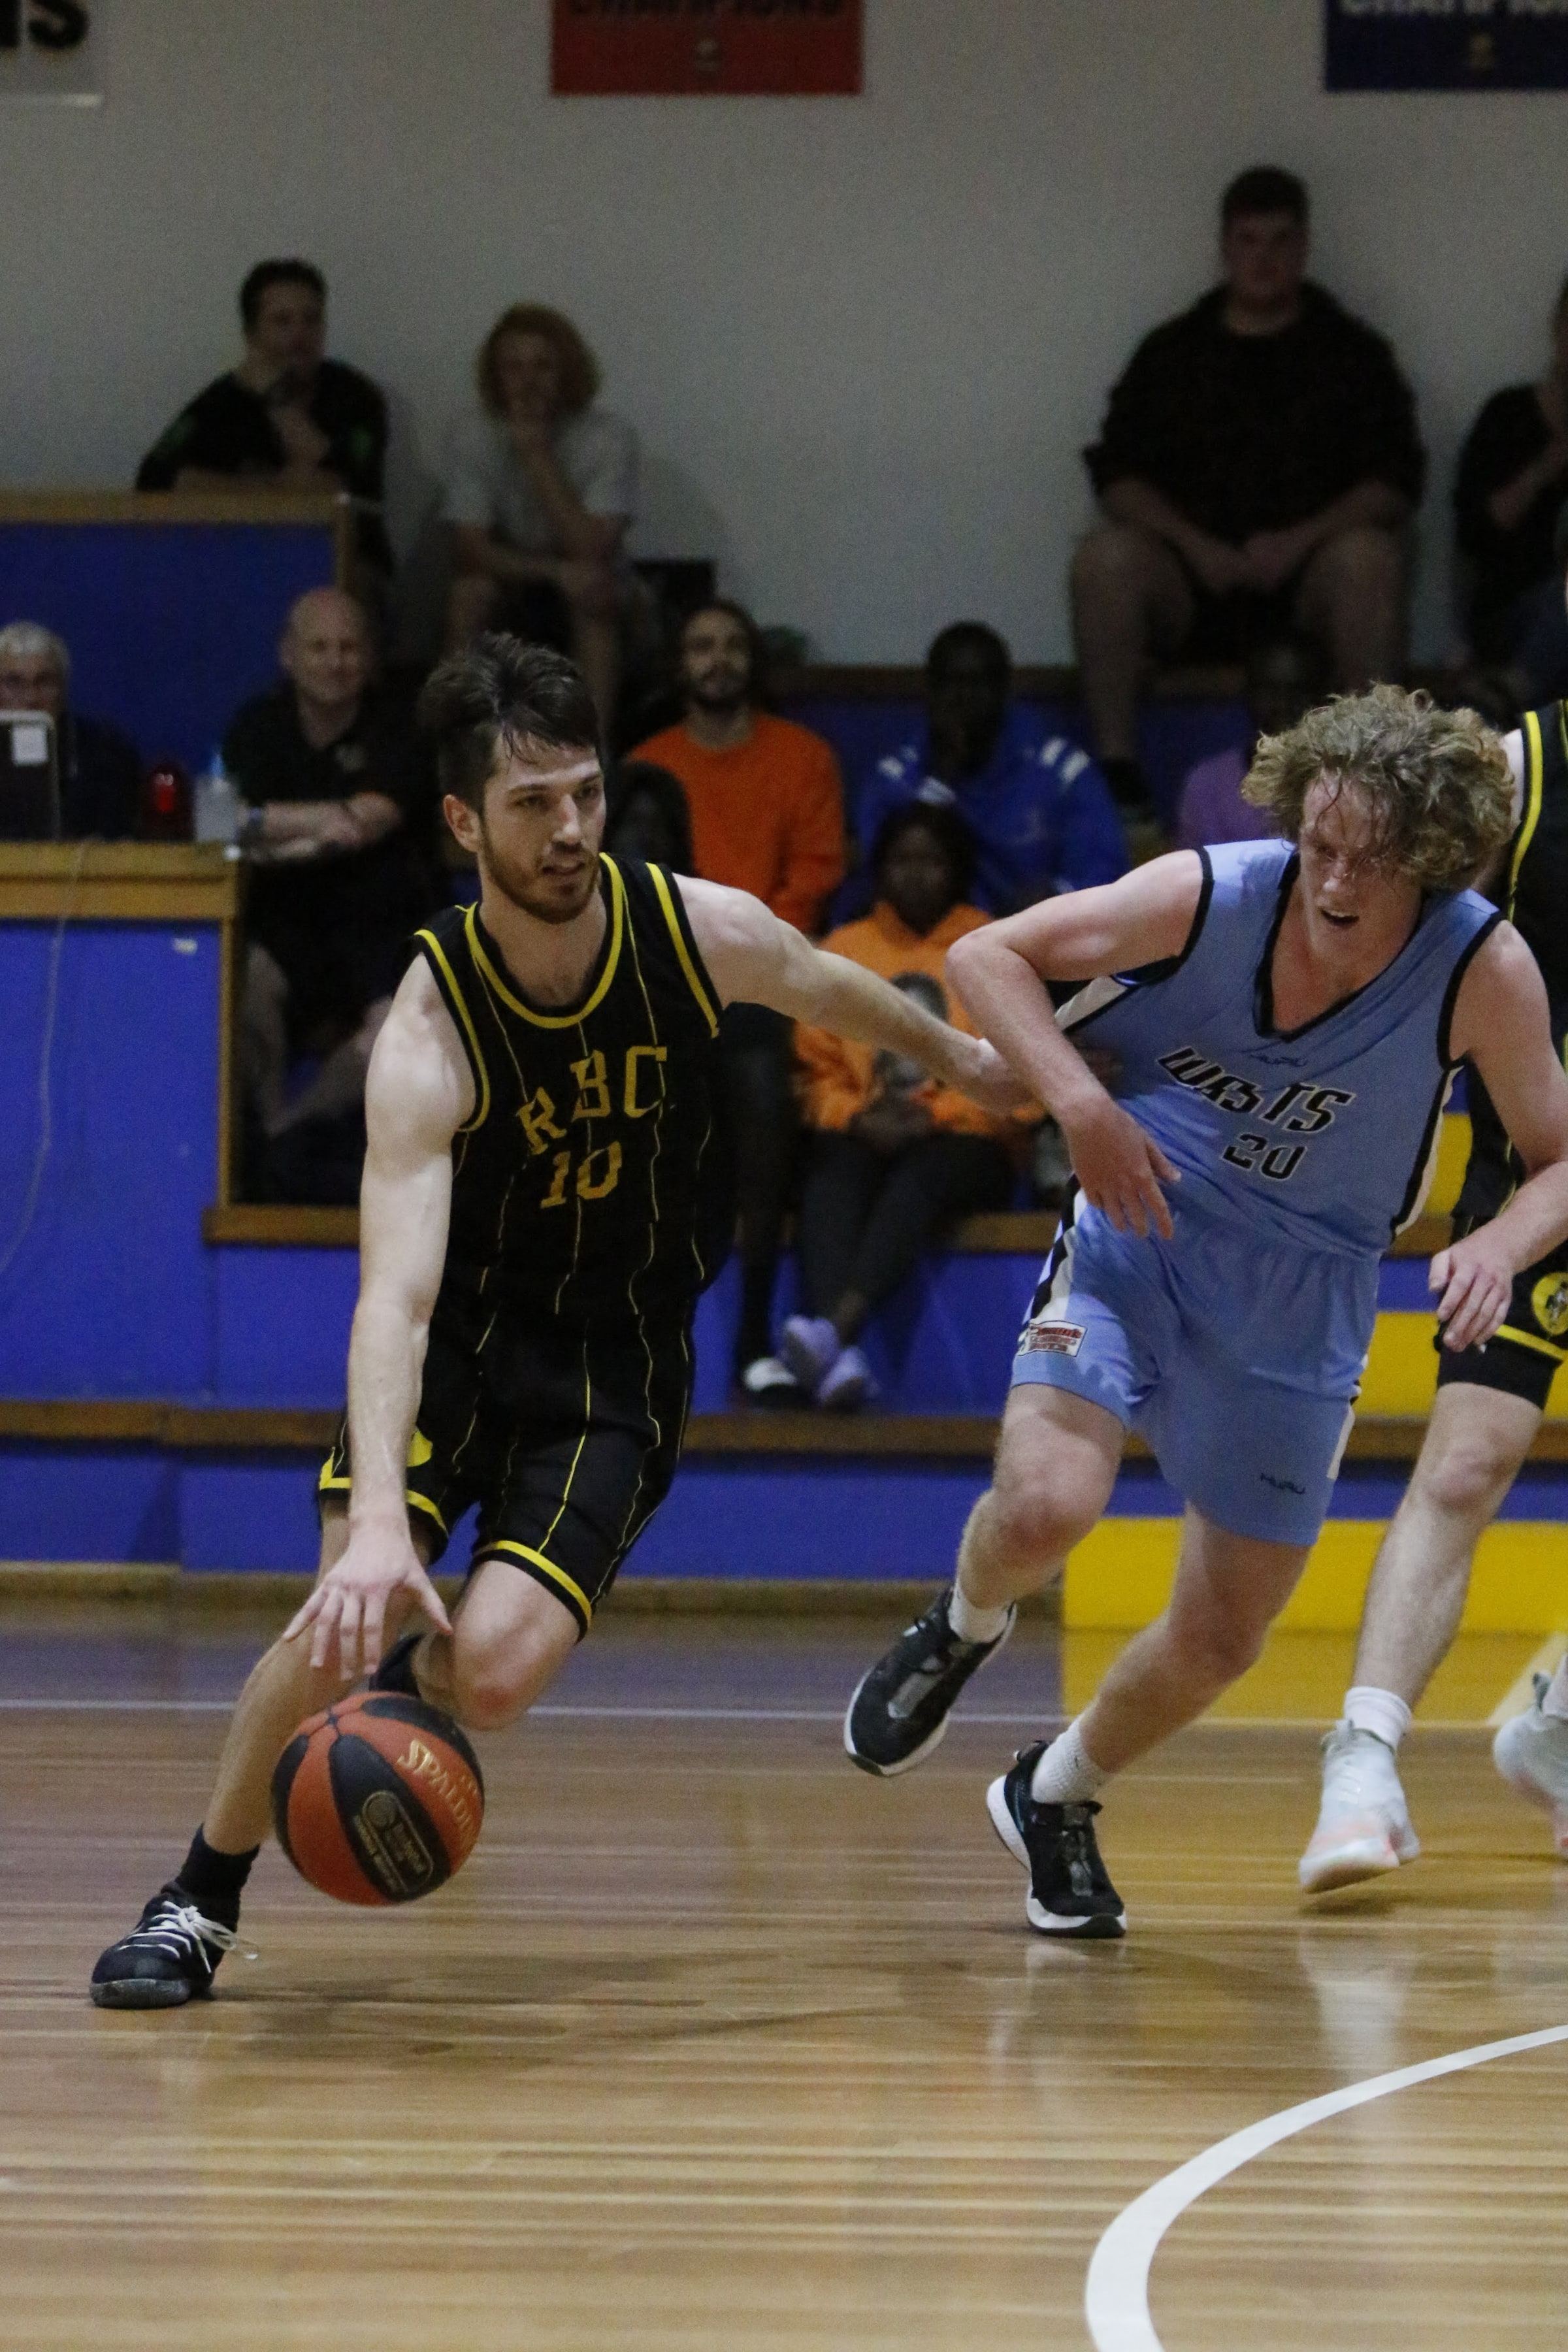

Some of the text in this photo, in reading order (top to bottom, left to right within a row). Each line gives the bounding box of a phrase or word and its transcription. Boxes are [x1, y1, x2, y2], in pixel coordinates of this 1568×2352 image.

[517, 1047, 667, 1155] RBC
[541, 1141, 622, 1209] 10
[1220, 1134, 1307, 1181] 20
